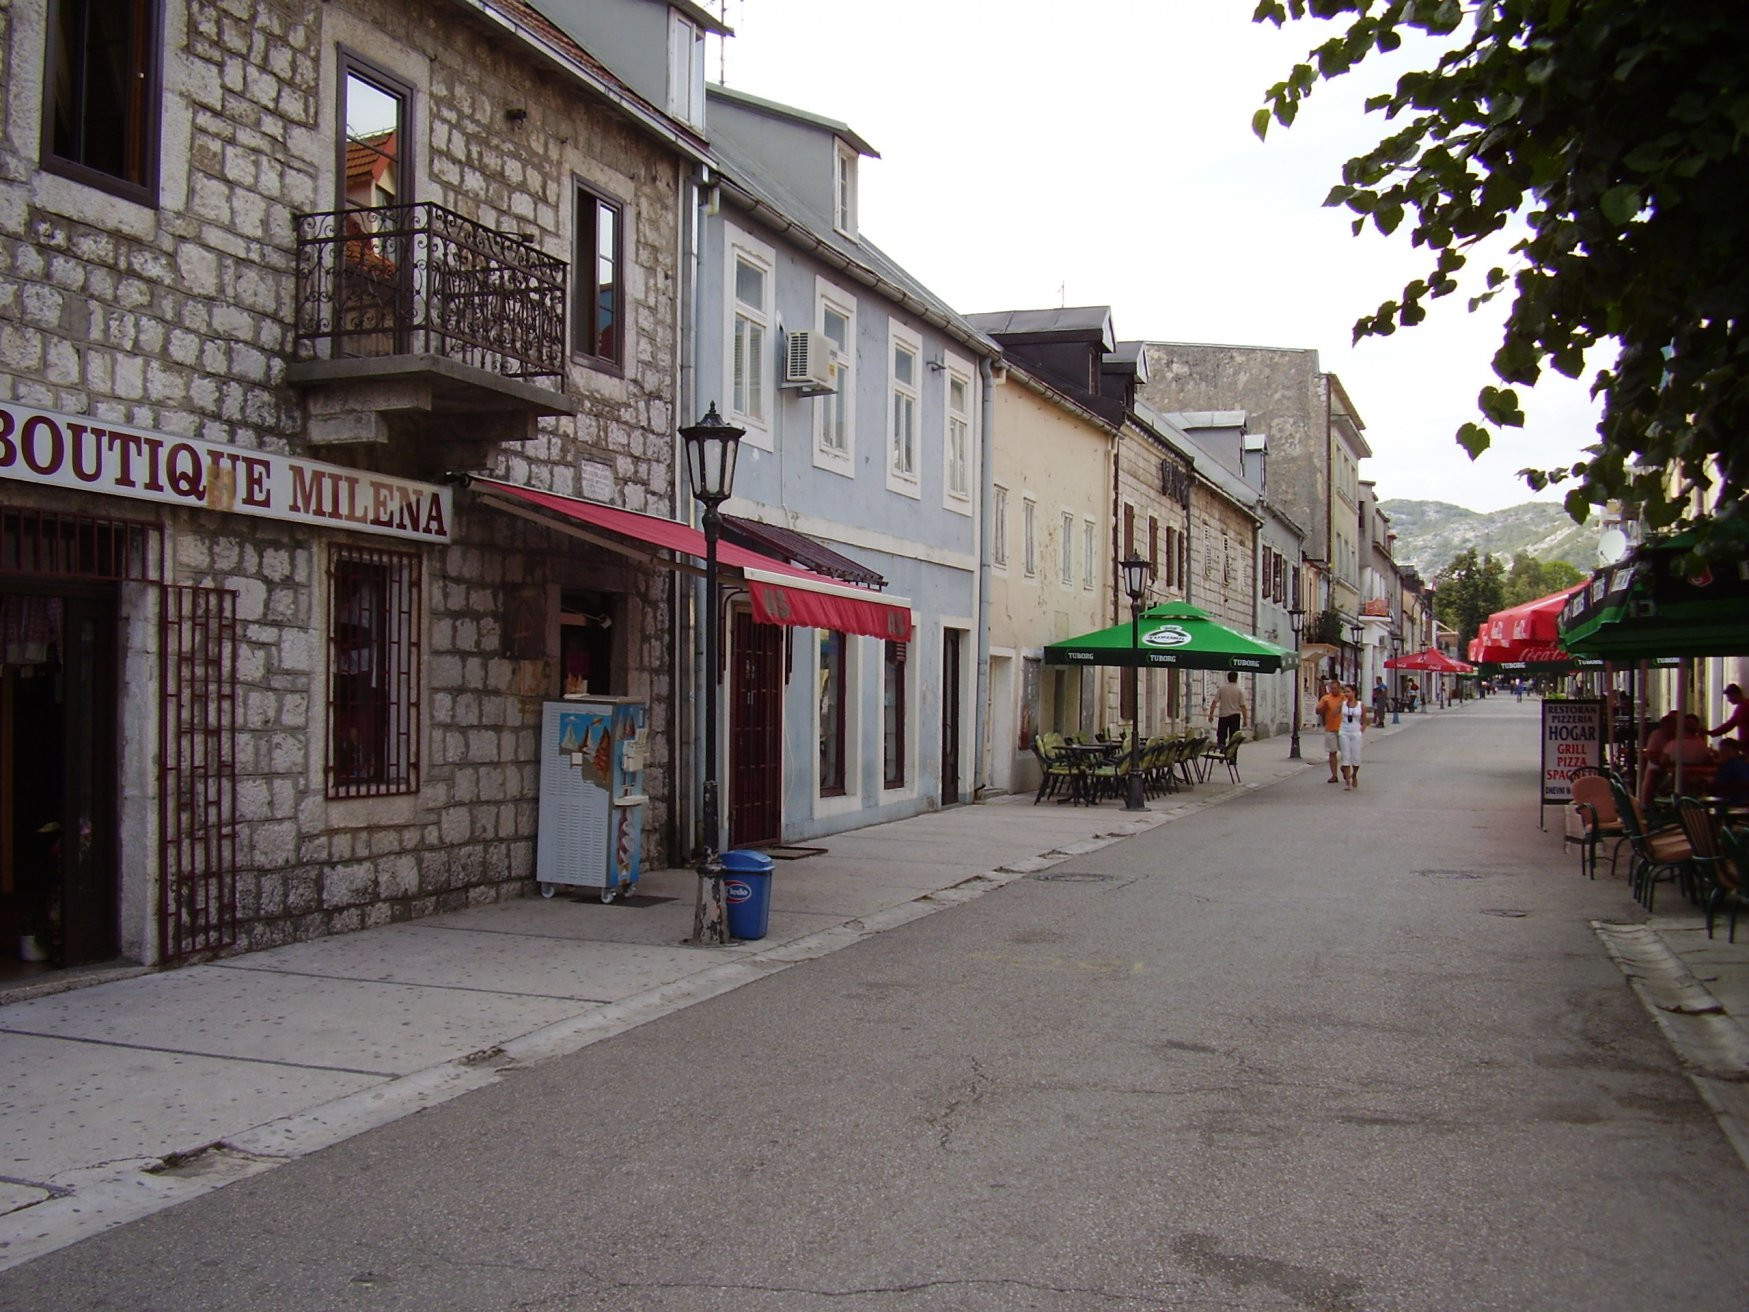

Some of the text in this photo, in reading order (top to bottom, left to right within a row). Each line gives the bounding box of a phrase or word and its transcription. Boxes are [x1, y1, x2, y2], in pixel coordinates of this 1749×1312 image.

[289, 464, 448, 537] MILENA
[1068, 652, 1094, 660] TUBORG
[1150, 654, 1177, 663] TUBORG
[1233, 658, 1260, 667] TUBORG
[1548, 705, 1597, 715] RESTORAN
[1552, 715, 1593, 724] PIZZERIA
[1549, 726, 1596, 741] HOGAR
[1557, 744, 1587, 755] GRILL
[1557, 757, 1588, 768] PIZZA
